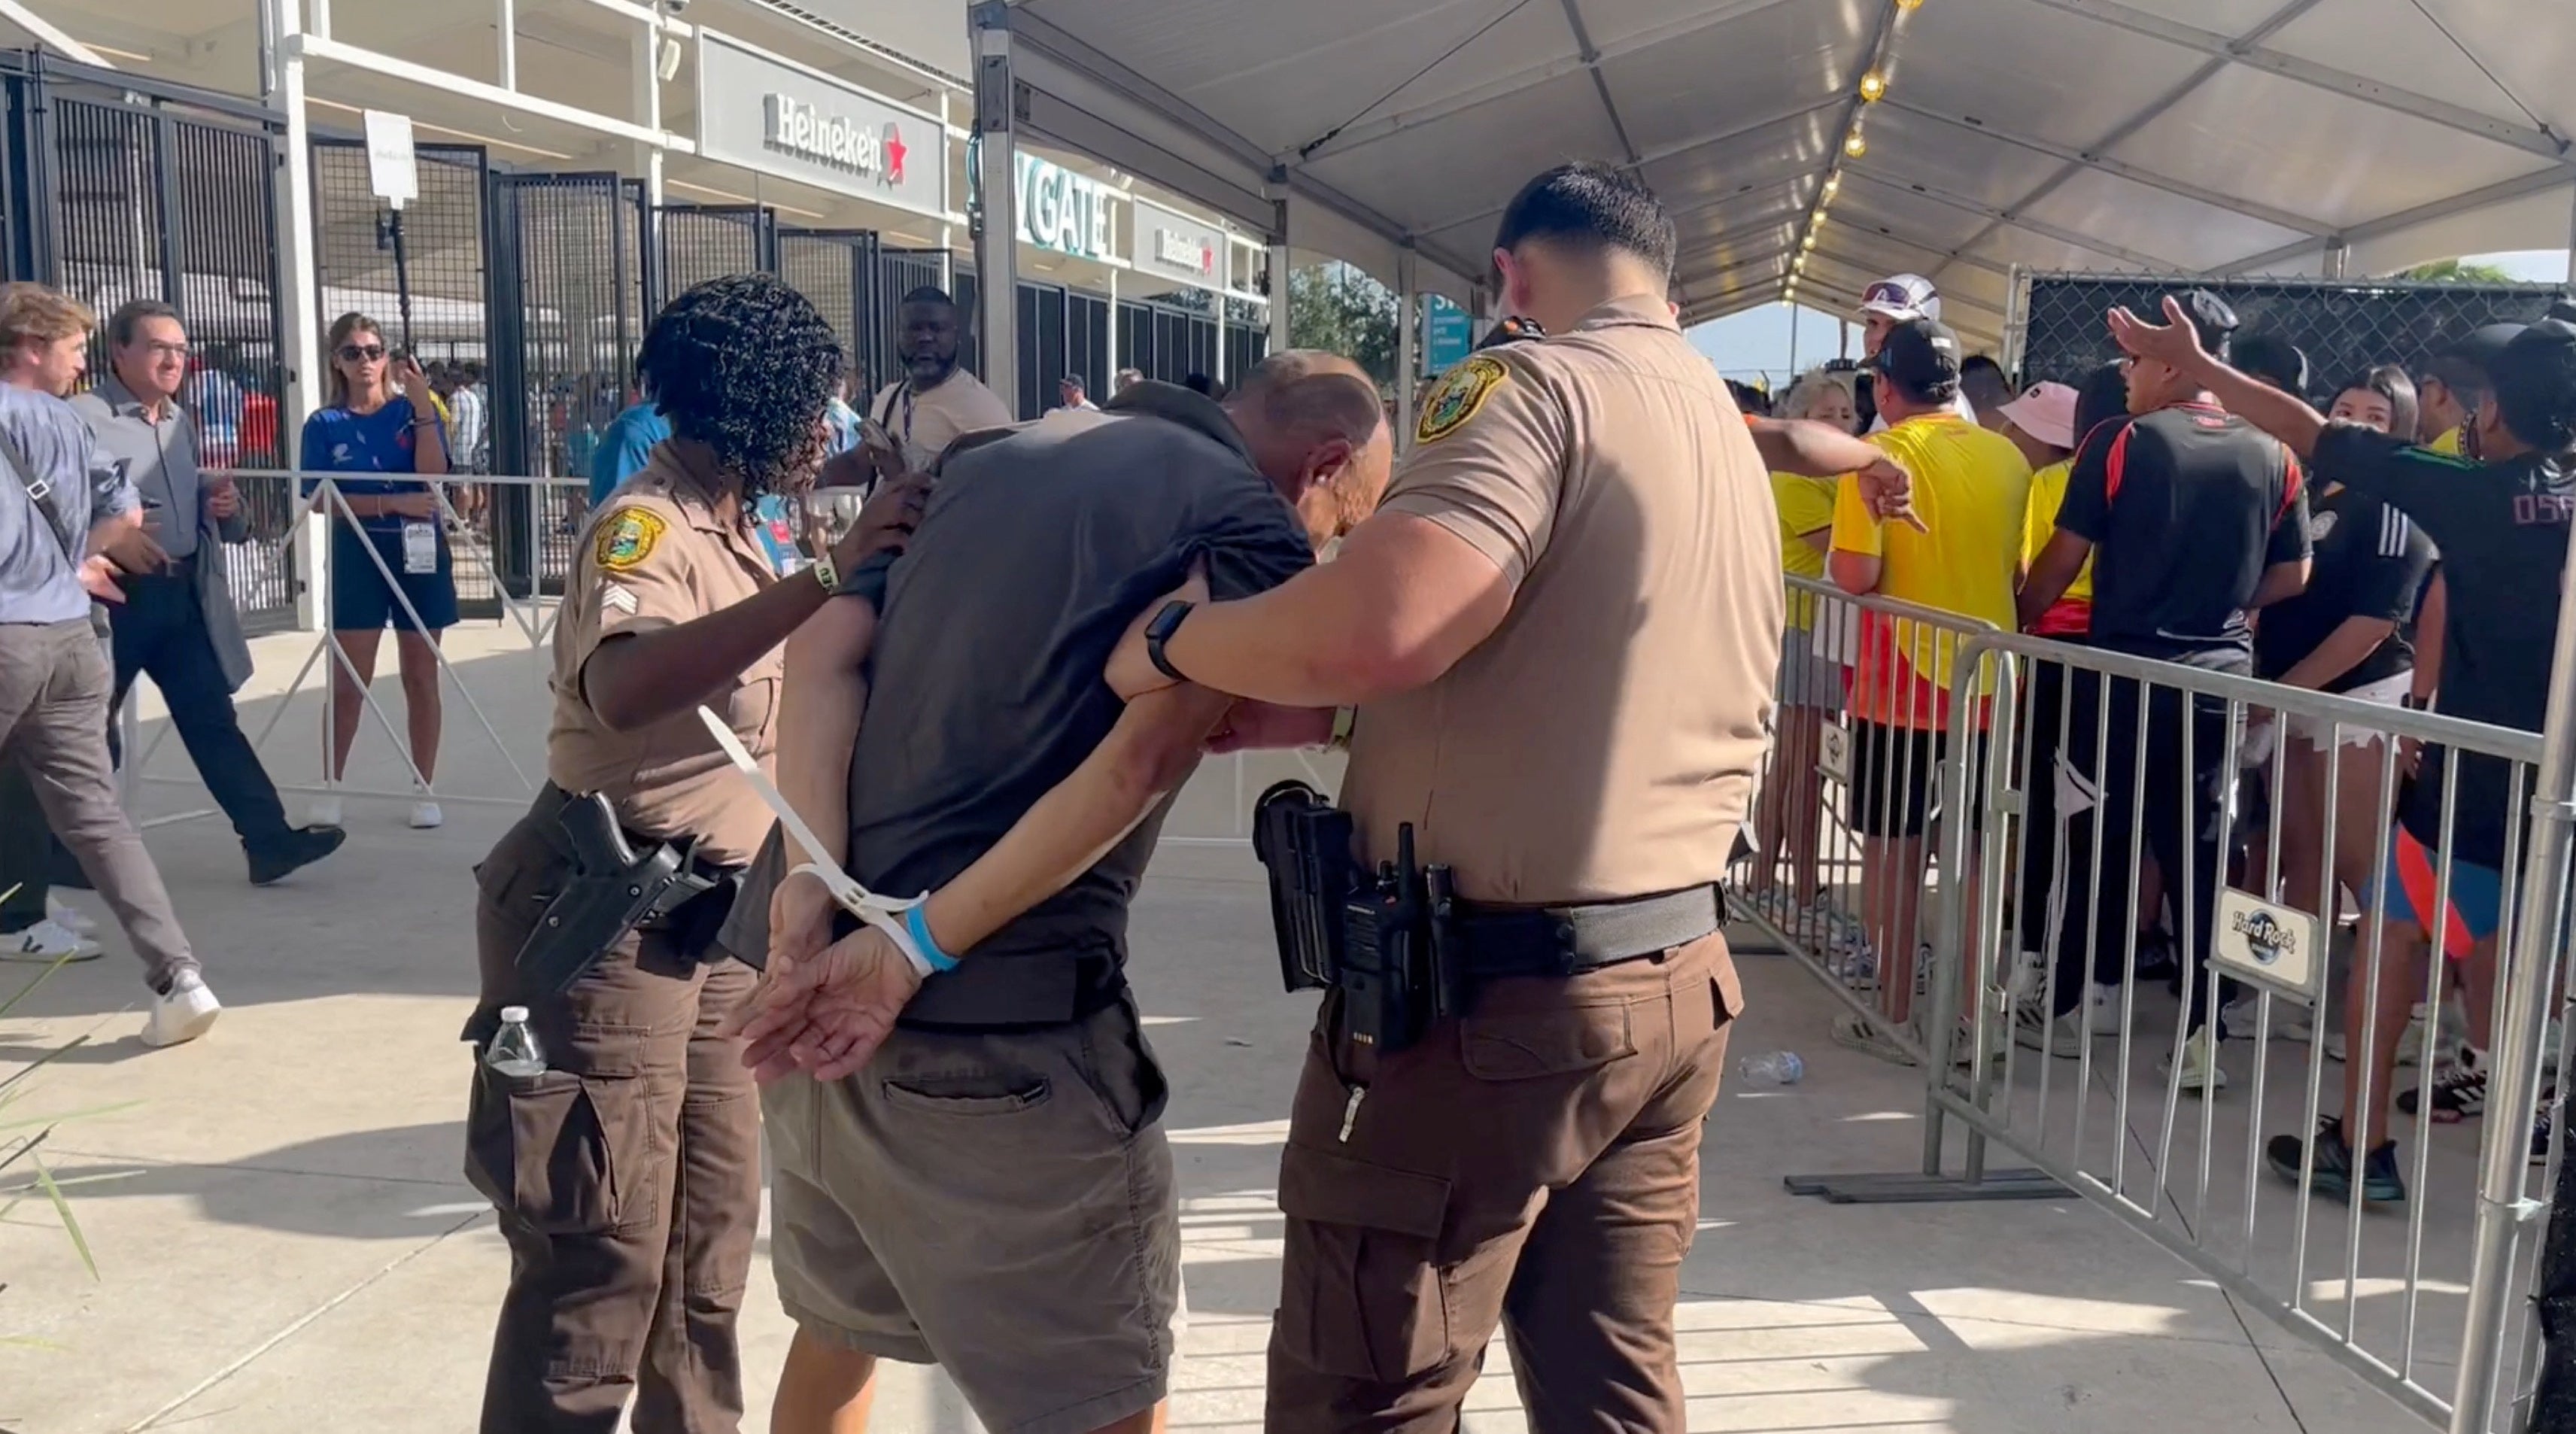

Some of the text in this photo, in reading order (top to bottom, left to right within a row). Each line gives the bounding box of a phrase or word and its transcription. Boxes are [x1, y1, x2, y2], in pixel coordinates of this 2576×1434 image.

[777, 93, 882, 172] Heineken
[1028, 156, 1107, 260] GATE
[2232, 910, 2264, 937] Hard
[2264, 922, 2296, 955] Rock
